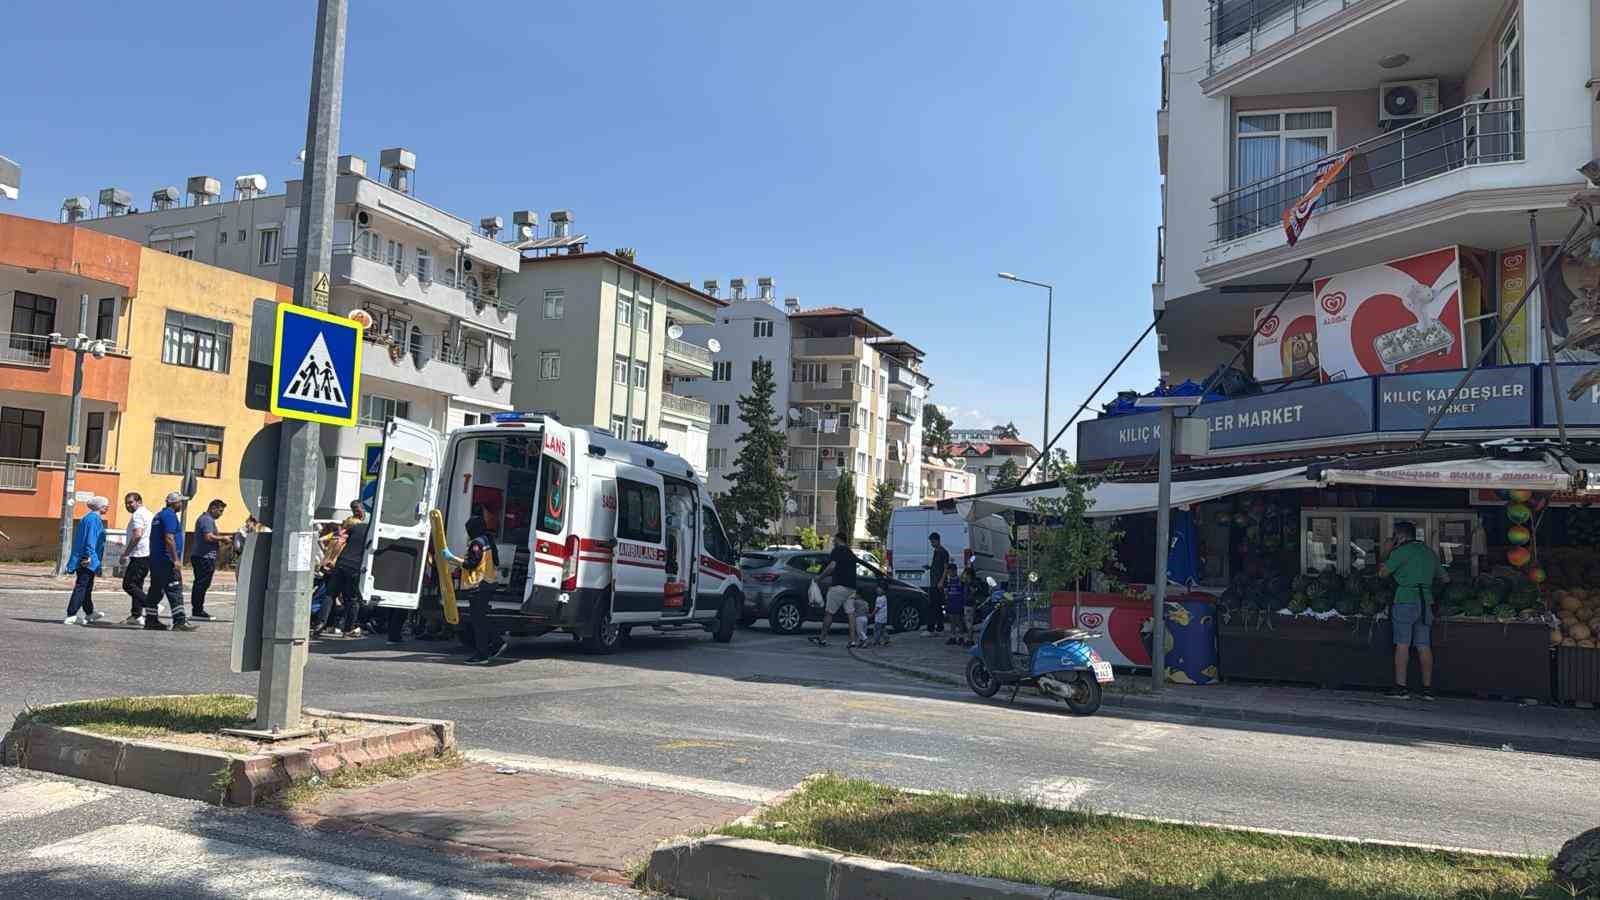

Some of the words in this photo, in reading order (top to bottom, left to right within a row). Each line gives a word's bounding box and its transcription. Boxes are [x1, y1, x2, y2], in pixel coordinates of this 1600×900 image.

[1383, 390, 1421, 404] KILIÇ
[1238, 405, 1304, 429] MARKET
[544, 432, 566, 457] LANS
[1119, 426, 1150, 443] KILIÇ
